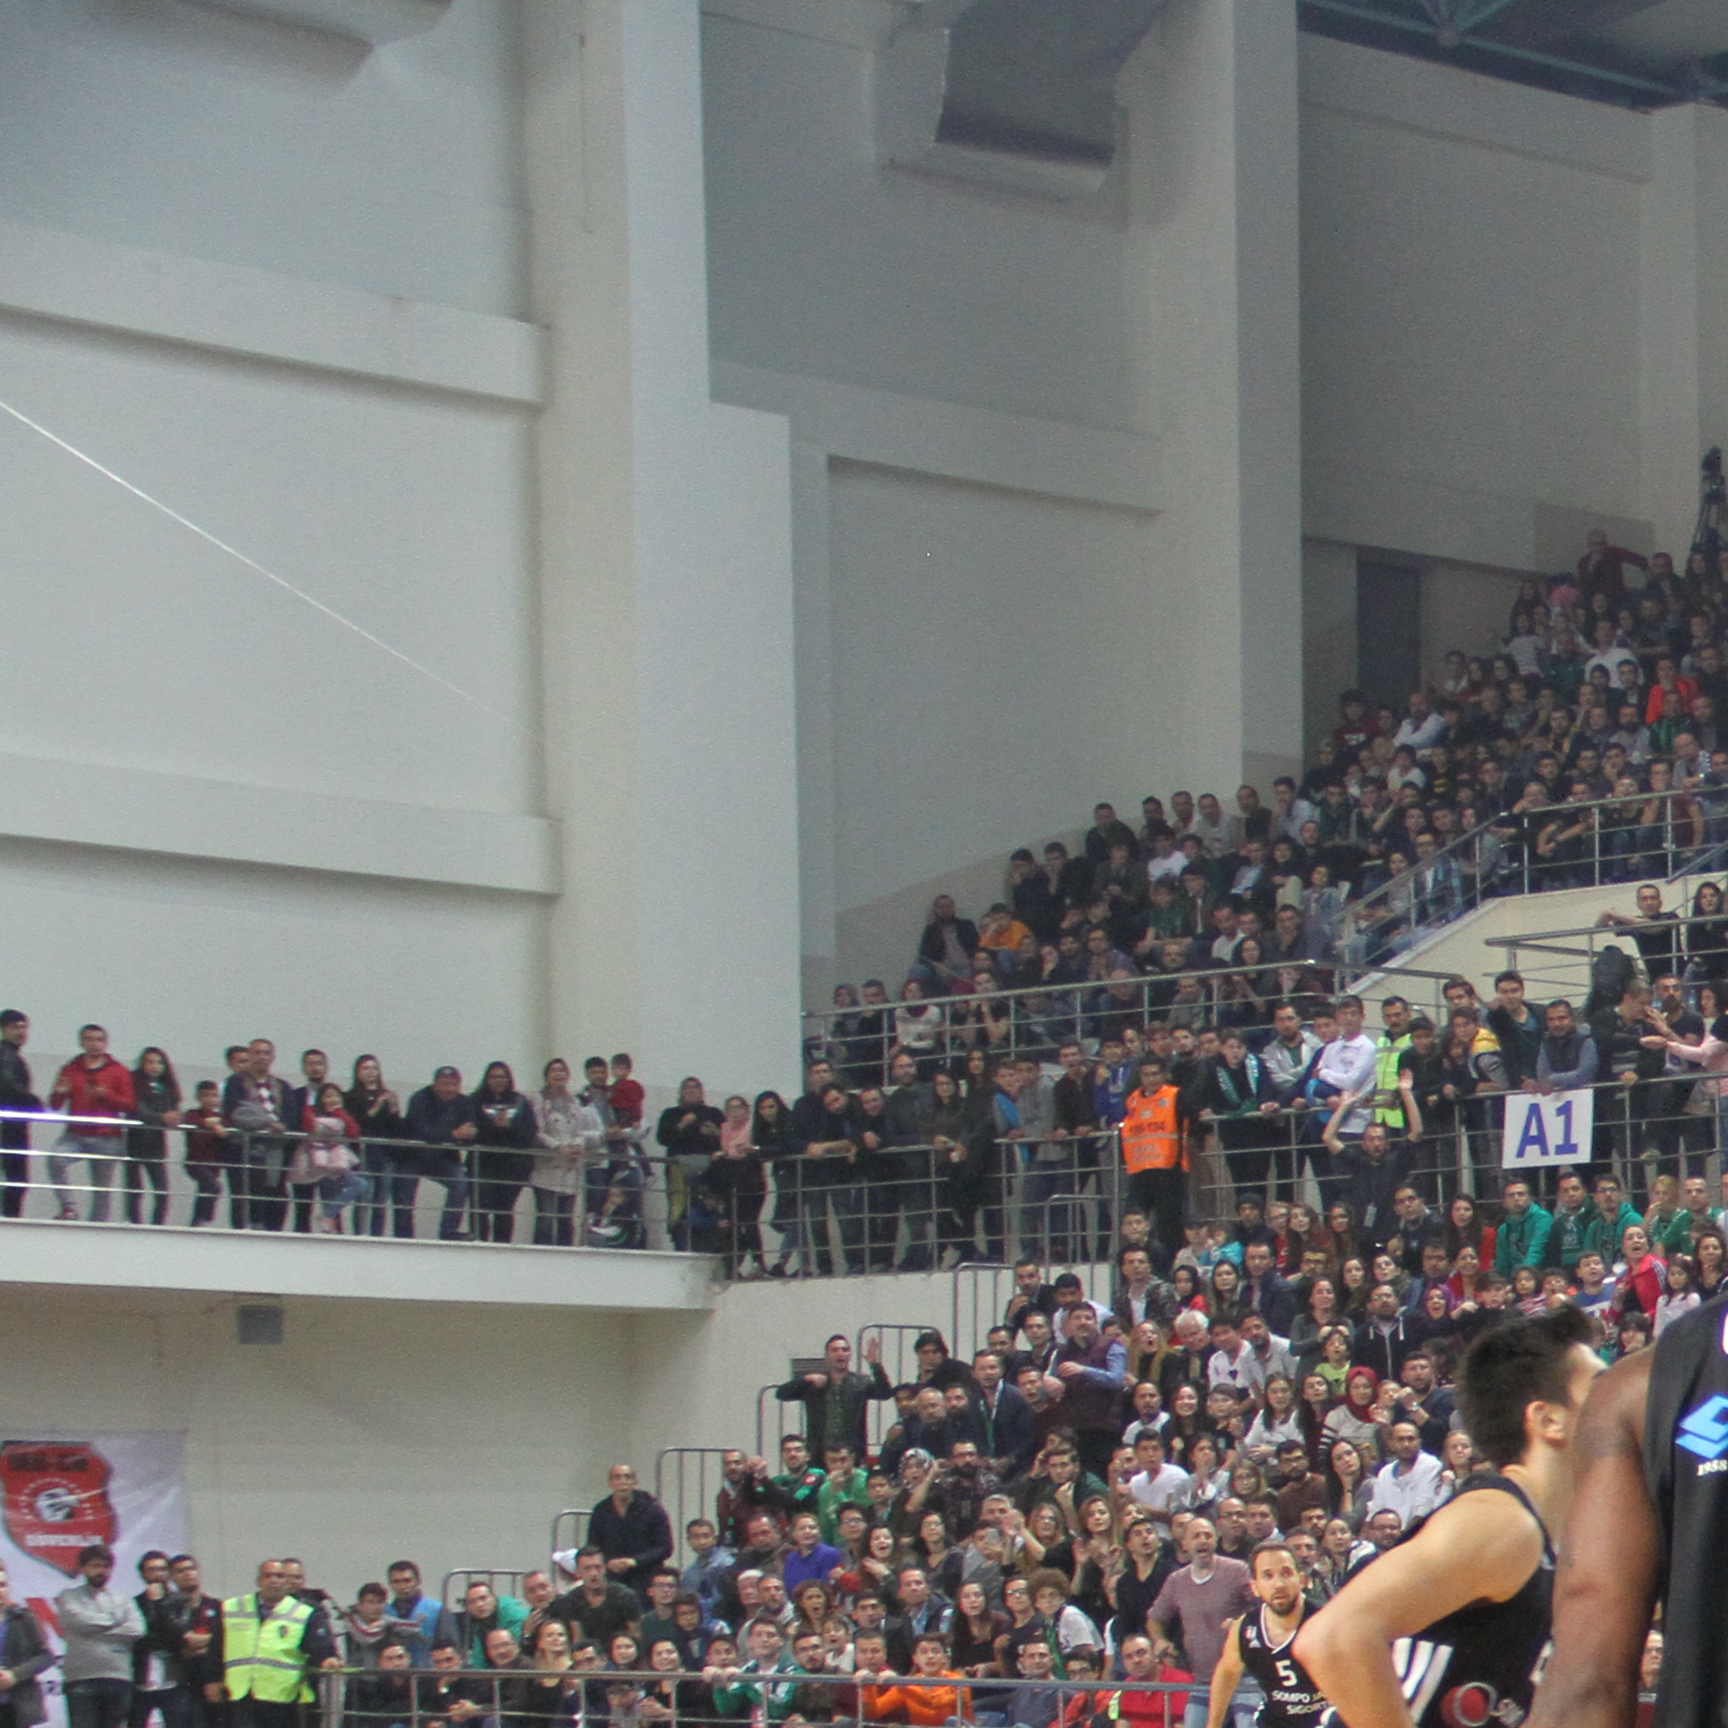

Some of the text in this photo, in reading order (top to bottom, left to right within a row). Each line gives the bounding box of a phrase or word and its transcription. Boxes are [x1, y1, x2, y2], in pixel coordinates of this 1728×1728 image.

[1515, 1102, 1580, 1160] A1
[1275, 1659, 1298, 1687] 5
[1272, 1690, 1311, 1704] SOMPO
